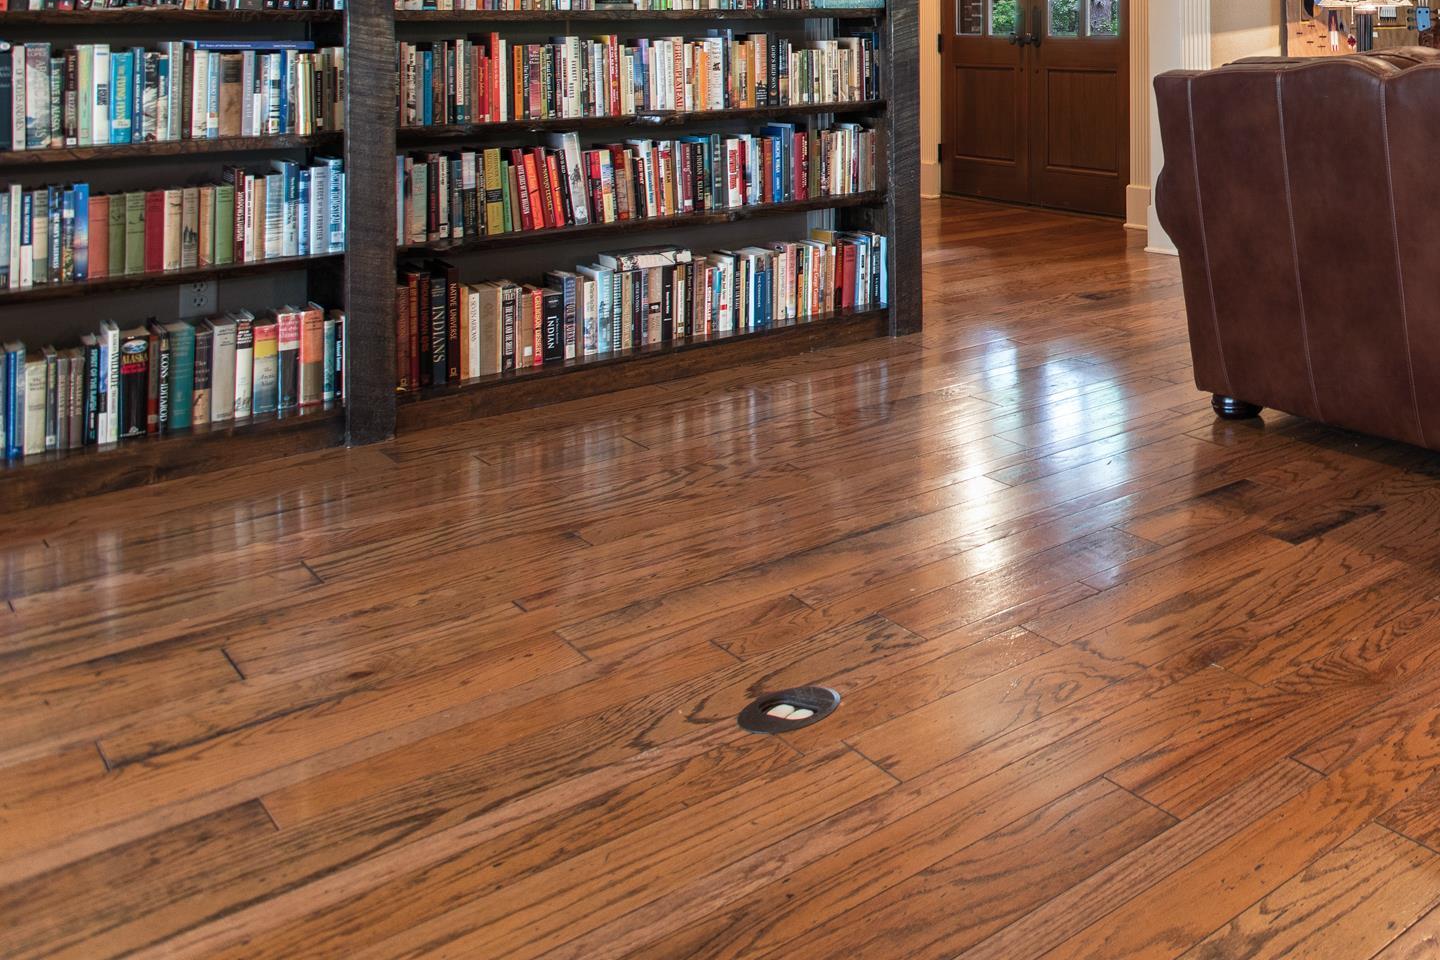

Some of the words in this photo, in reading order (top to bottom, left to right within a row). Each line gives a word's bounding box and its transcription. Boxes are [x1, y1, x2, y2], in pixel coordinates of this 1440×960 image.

[68, 55, 76, 72] MARK
[674, 44, 683, 62] FIRE
[675, 70, 683, 108] PLATEAU
[51, 104, 60, 131] ALASKA
[316, 181, 324, 200] HEROES
[331, 170, 341, 189] ARCTIC
[330, 191, 341, 224] HOMESTEAD
[432, 305, 445, 363] INDIANS
[547, 316, 557, 349] INDIAN
[111, 352, 119, 388] WILDLIFE
[121, 352, 149, 364] ALASKA
[160, 353, 169, 379] ICONS
[160, 383, 169, 422] IDITAROD
